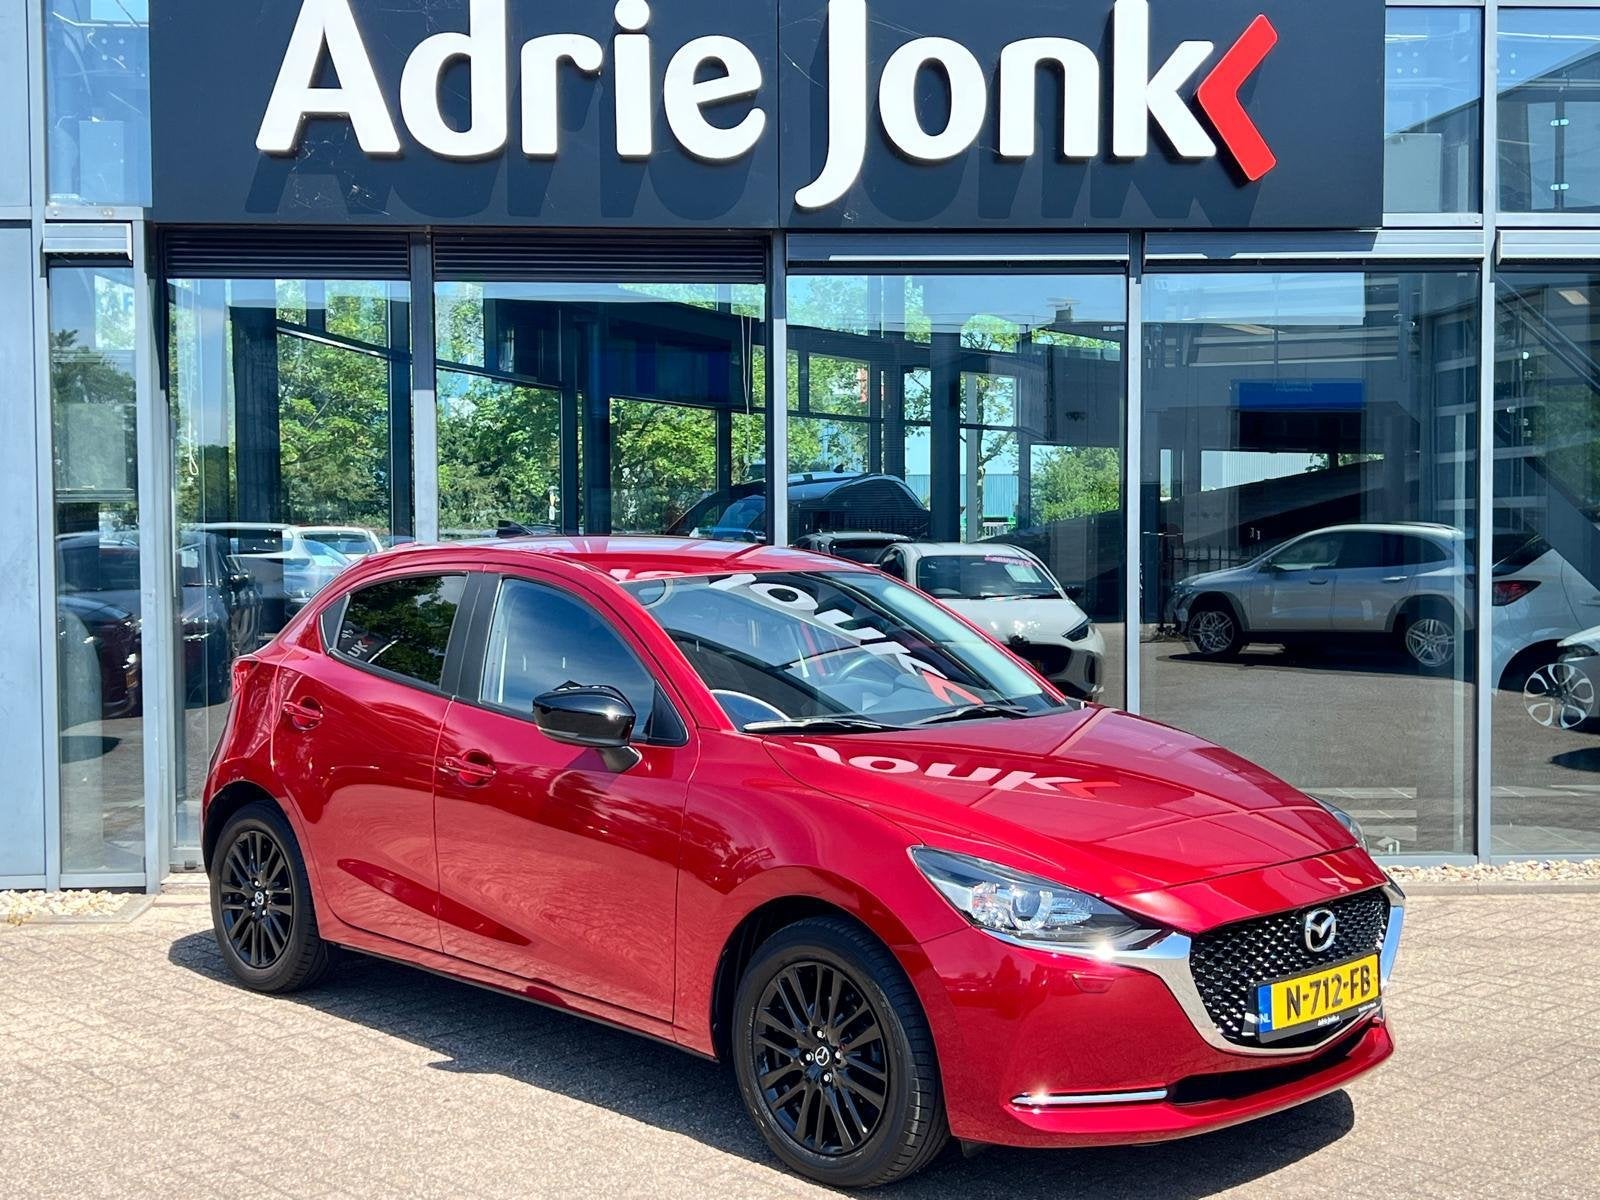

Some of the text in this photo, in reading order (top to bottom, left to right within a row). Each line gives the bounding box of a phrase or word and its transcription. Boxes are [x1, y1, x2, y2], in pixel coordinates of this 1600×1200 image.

[256, 0, 1217, 208] Adrie Jonk
[1260, 964, 1371, 1024] NL N-712-FB
